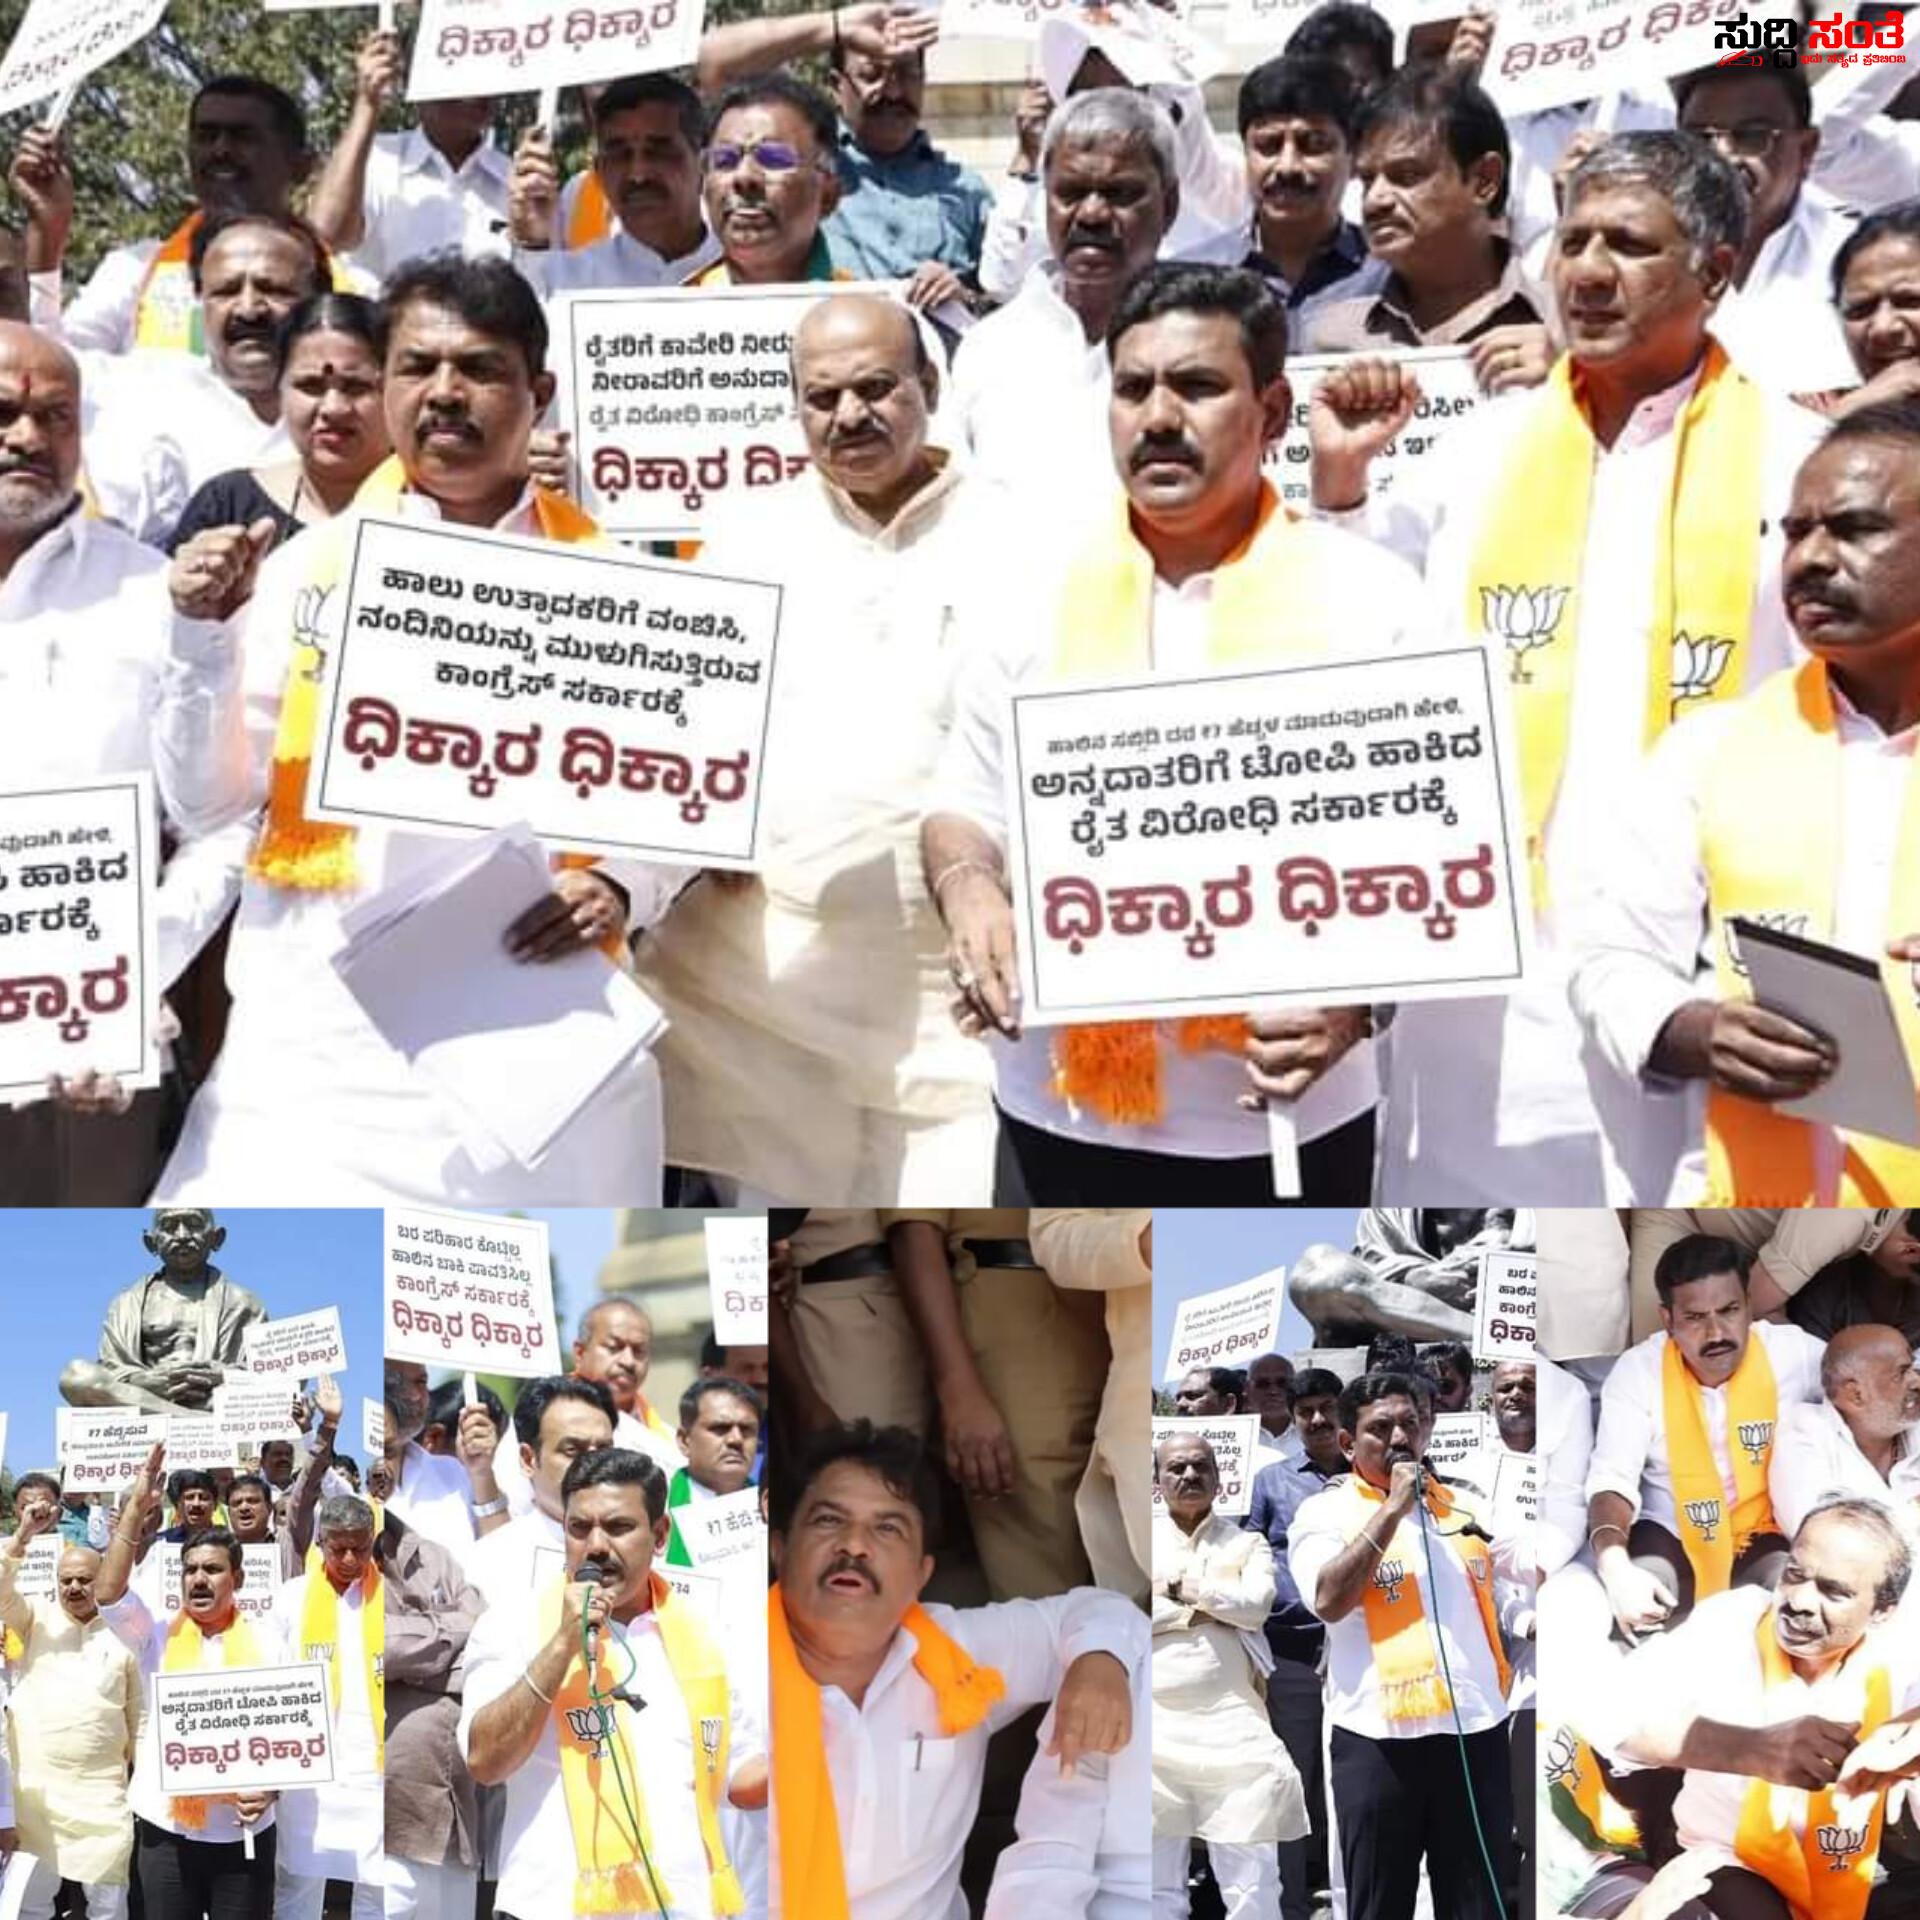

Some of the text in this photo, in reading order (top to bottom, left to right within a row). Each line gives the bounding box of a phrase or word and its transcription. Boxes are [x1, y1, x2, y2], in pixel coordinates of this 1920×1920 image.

[437, 15, 552, 67] ಧಿಕ್ಕಾರ
[586, 332, 653, 367] ರೈತರಿಗೆ
[660, 332, 734, 355] ಕಾವೇರಿ
[592, 367, 789, 390] ನೀರಾವರಿಗೆ ಅನುದಾ
[592, 446, 729, 511] ಧಿಕ್ಕಾರ
[383, 566, 747, 643] ಹಾಲು ಉತ್ಪಾದಕರಿಗೆ ವಂಚಿಸಿ,
[357, 604, 760, 688] ನಂದಿನಿಯನ್ನು ಮುಳುಗಿಸುತ್ತಿರುವ
[435, 660, 687, 728] ಕಾಂಗ್ರೆಸ್ ಸರ್ಕಾರಕ್ಕೆ
[344, 697, 750, 823] ಧಿಕ್ಕಾರ ಧಿಕ್ಕಾರ
[1033, 726, 1482, 806] ಅನ್ನದಾತರಿಗೆ ಟೋಪಿ ಹಾಕಿದ
[1072, 777, 1458, 857] ರೈತ ವಿರೋಧಿ ಸರ್ಕಾರಕ್ಕೆ
[19, 851, 128, 888] ಹಾಕಿದ
[1043, 843, 1495, 958] ಧಿಕ್ಕಾರ ಧಿಕ್ಕಾರ
[0, 954, 129, 1043] ಕ್ಕಾರ
[392, 1249, 434, 1268] ಹಾಲಿನ
[437, 1256, 465, 1273] ಬಾಕಿ
[397, 1224, 419, 1240] ಬರ
[423, 1229, 474, 1250] ಪರಿಹಾರ
[396, 1274, 535, 1317] ಕಾಂಗ್ರೆಸ್ ಸರ್ಕಾರಕ್ಕೆ
[392, 1299, 463, 1349] ಧಿಕ್ಕಾರ
[471, 1312, 543, 1359] ಧಿಕ್ಕಾರ
[165, 1733, 326, 1774] ಧಿಕ್ಕಾರ ಧಿಕ್ಕಾರ
